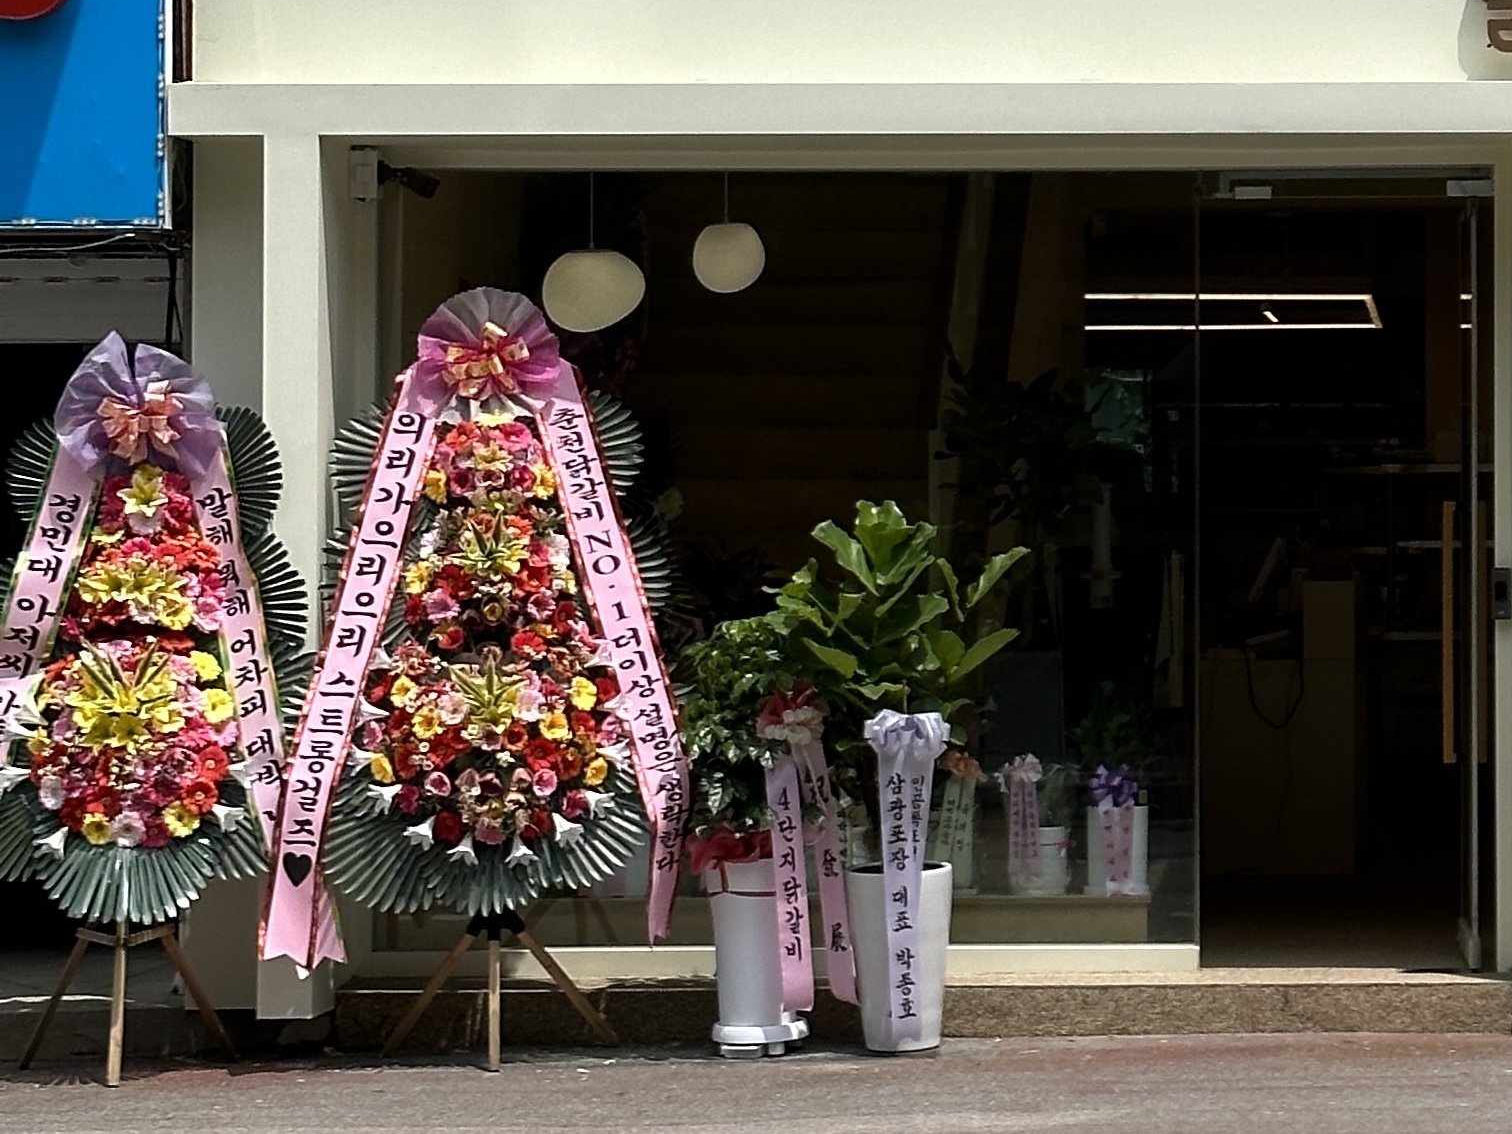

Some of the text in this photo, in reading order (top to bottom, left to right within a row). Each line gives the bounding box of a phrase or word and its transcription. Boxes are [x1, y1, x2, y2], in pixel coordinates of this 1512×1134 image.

[548, 408, 604, 521] 춘천닭갈비
[28, 493, 82, 584] 경민대
[196, 487, 234, 546] 말해
[230, 628, 270, 719] 어차피
[892, 885, 914, 933] 대표
